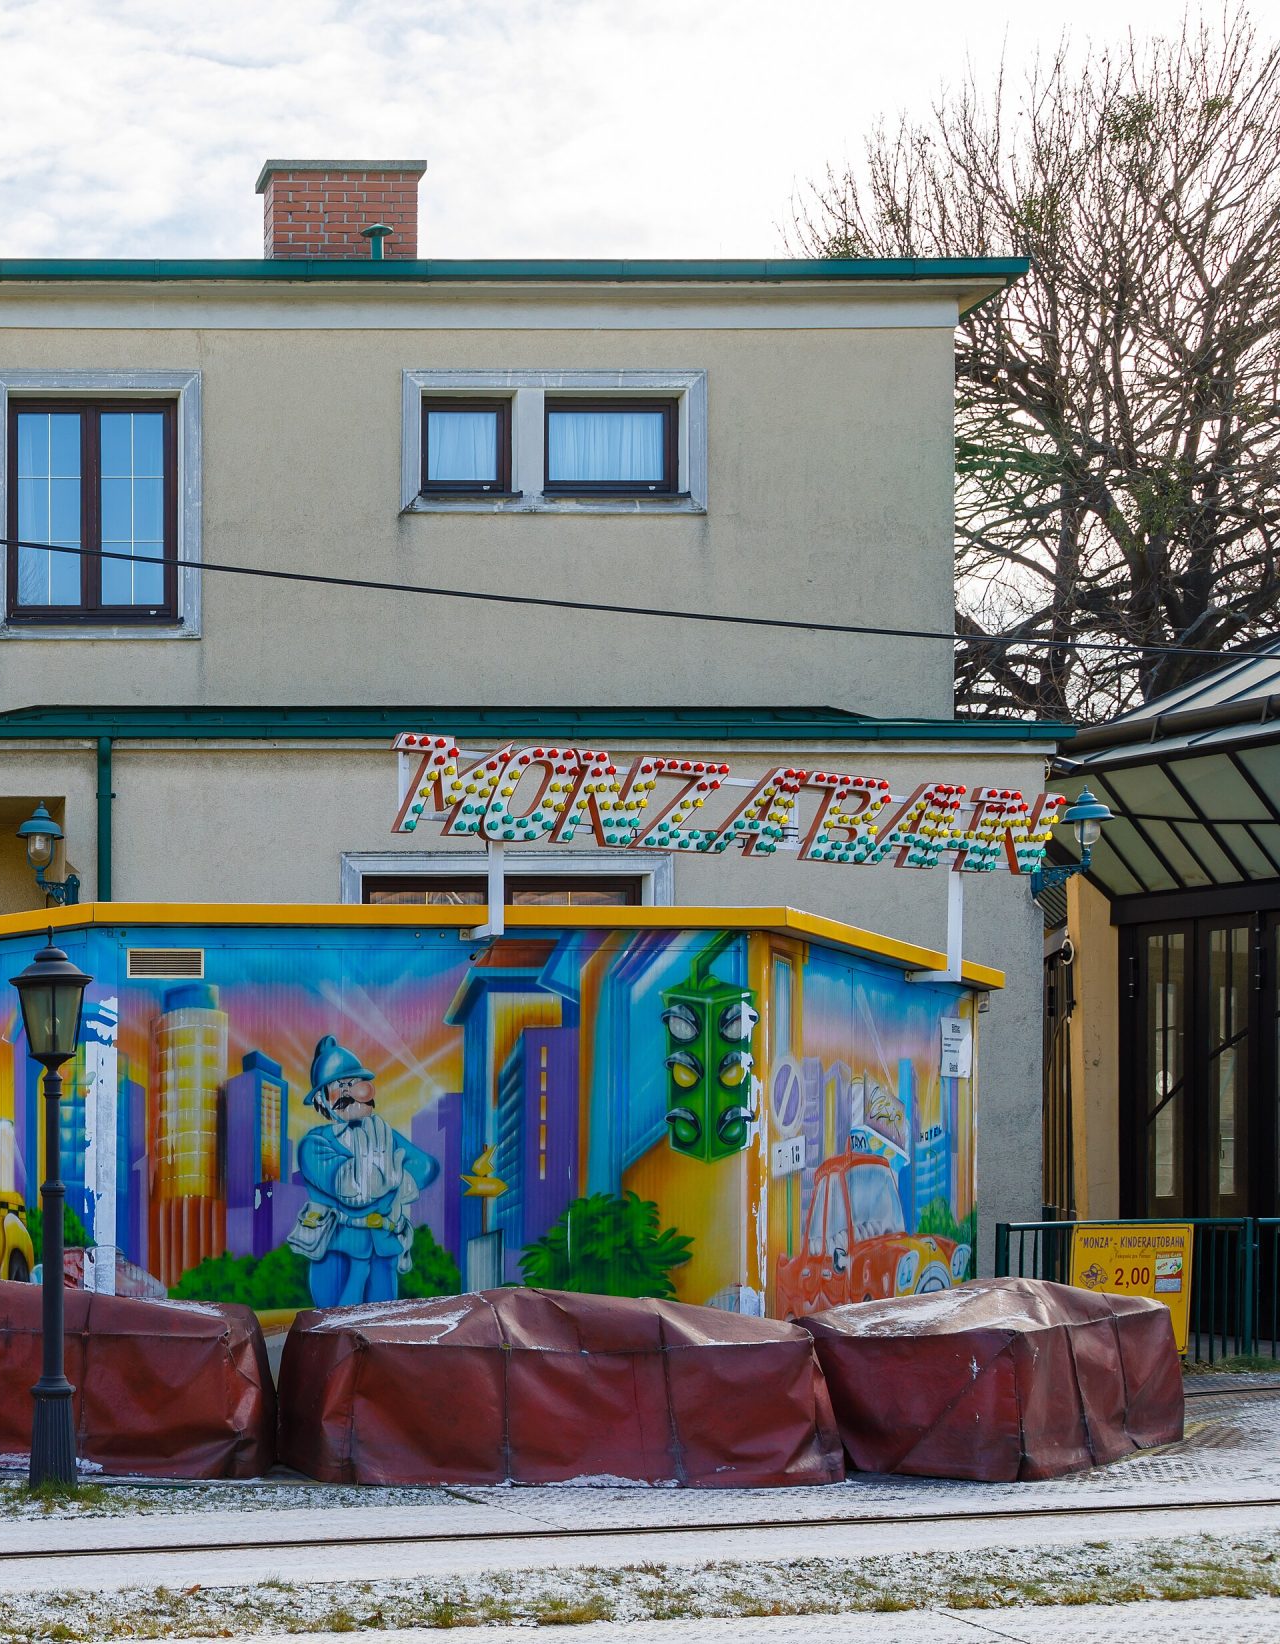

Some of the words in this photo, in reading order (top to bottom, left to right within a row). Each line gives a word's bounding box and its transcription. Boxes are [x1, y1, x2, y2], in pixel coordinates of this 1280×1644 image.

[920, 1125, 942, 1141] HOTEL
[1120, 1236, 1185, 1249] KINDERAUTOBAHN
[1114, 1266, 1150, 1289] 2,00
